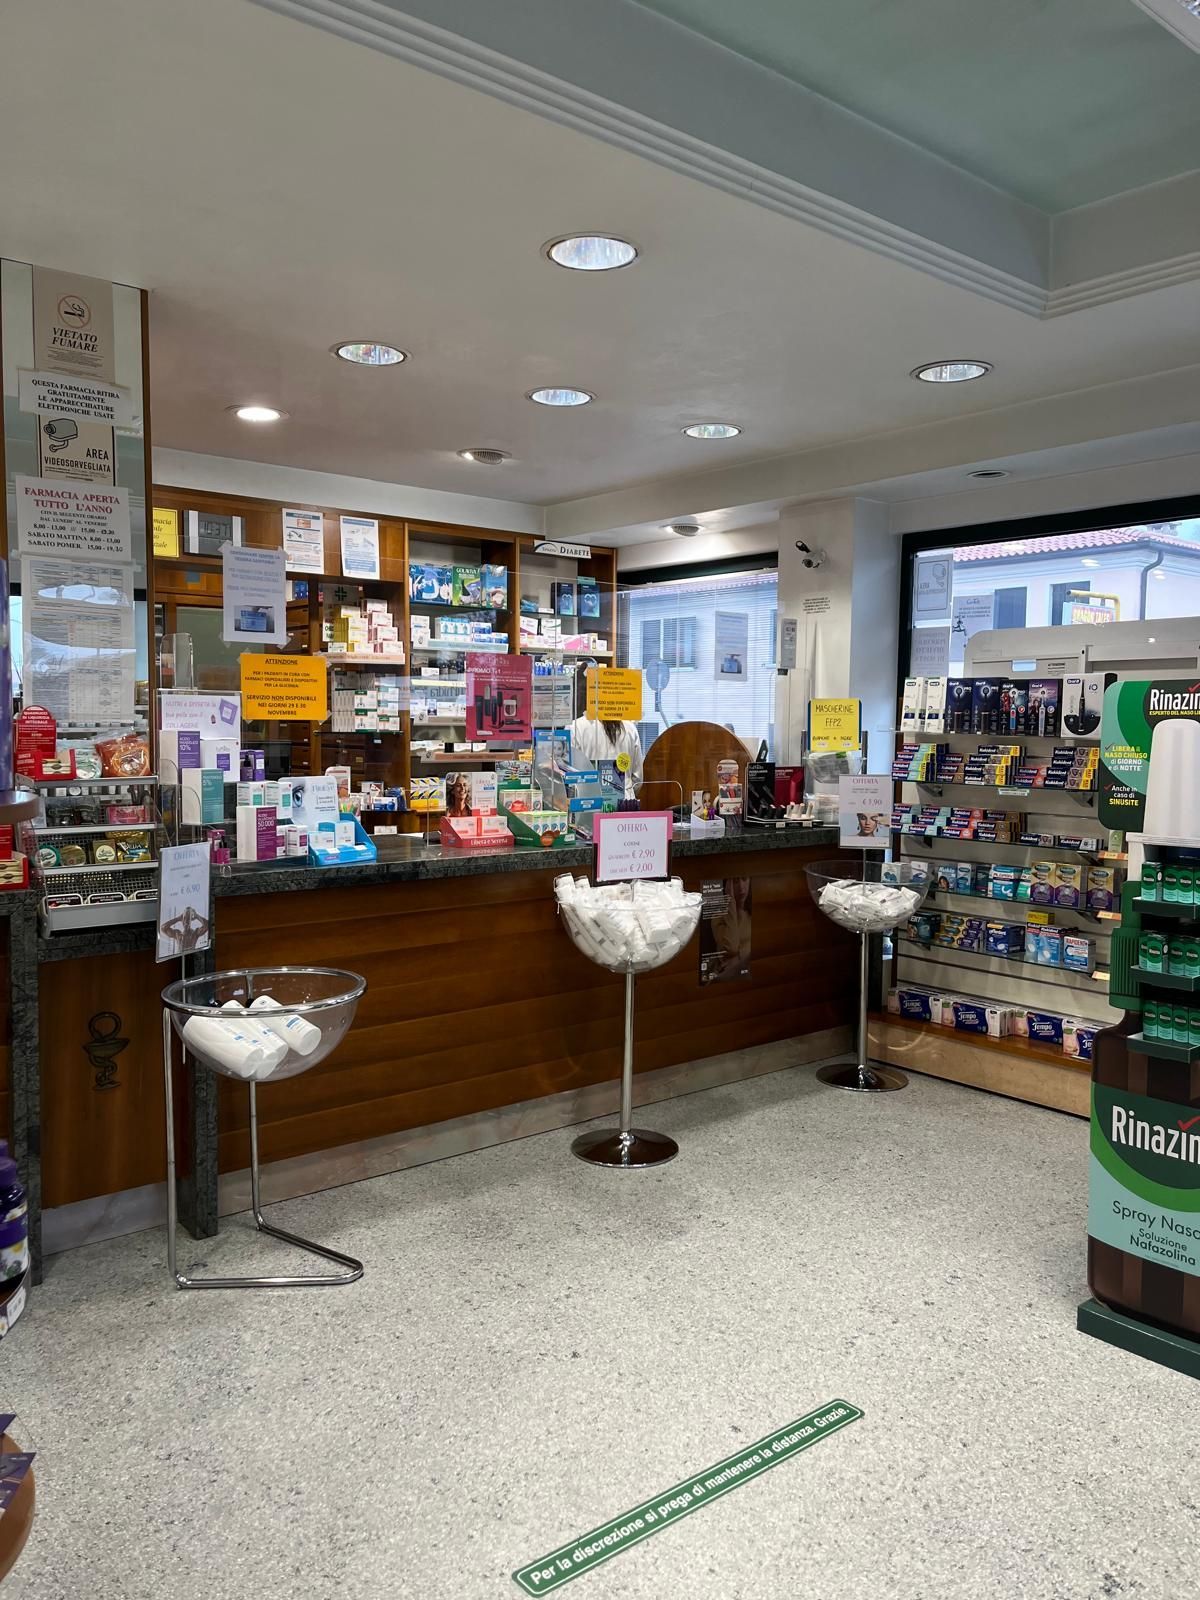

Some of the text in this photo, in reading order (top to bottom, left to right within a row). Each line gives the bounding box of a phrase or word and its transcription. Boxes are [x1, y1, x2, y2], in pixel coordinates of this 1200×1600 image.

[53, 327, 98, 343] VIETATO
[52, 337, 98, 353] FUMARE
[32, 379, 120, 399] QUESTA FARMACIA RITIRA
[47, 389, 106, 403] GRATUITAMENTE
[38, 402, 115, 420] ELETTRONICHE USATE
[50, 397, 115, 412] APPARECCHIATURE
[86, 448, 109, 460] AREA
[44, 456, 111, 473] VIDEOSORVEGLIATA
[24, 487, 120, 504] FARMACIA APERTA
[33, 499, 113, 514] TUTTO L'ANNO
[27, 531, 55, 539] SABATO
[56, 533, 87, 541] MATTINA
[560, 546, 590, 556] DIABETE
[815, 704, 854, 713] MASCHERINE
[825, 717, 842, 727] FFP2
[1109, 798, 1139, 806] SINUSITE
[958, 1012, 976, 1022] Tempo
[1032, 1022, 1053, 1032] Tempo
[1111, 1105, 1200, 1165] Rinazin
[1112, 1200, 1156, 1228] Spray
[1139, 1228, 1187, 1251] Soluzione
[1130, 1235, 1196, 1266] Nafazolina
[530, 1406, 850, 1585] Per la discrezione si prega di mantenere la distanza. Grazie.
